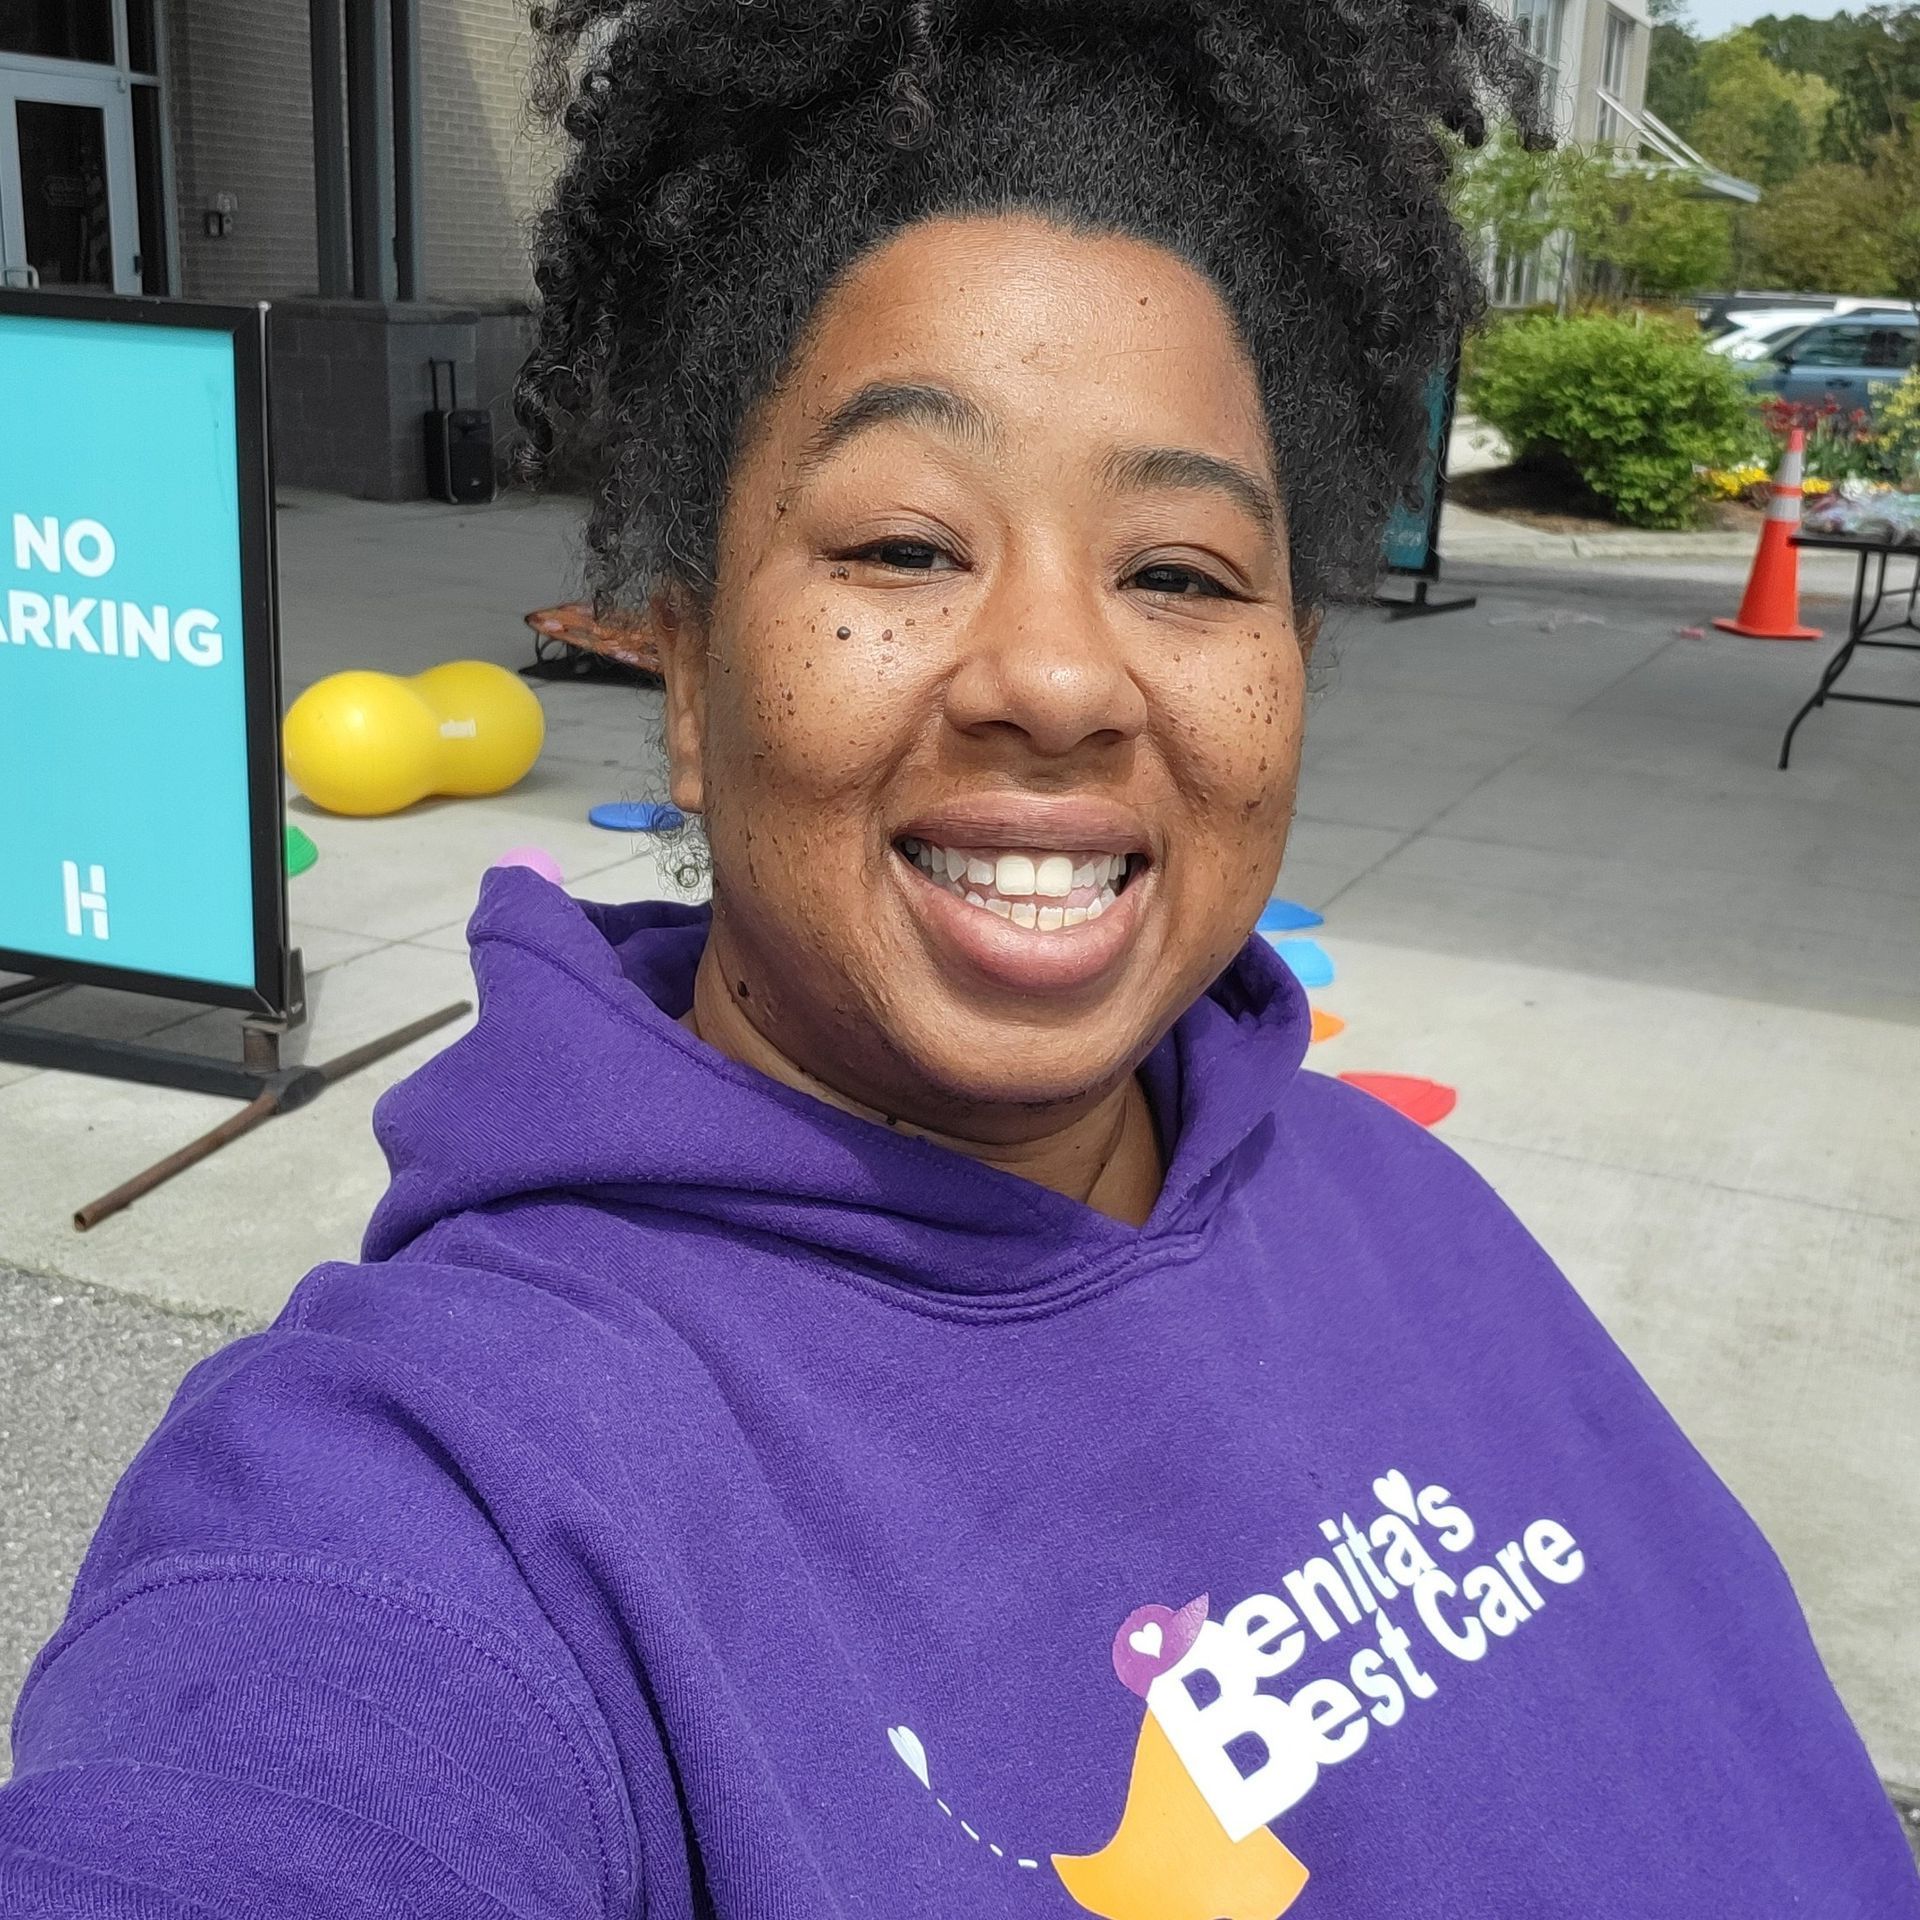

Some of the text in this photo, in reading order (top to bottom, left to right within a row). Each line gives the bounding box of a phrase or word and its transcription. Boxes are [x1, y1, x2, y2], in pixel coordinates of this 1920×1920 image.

[13, 513, 116, 578] NO
[0, 588, 224, 667] RKING
[62, 860, 110, 940] H
[1146, 1468, 1475, 1843] Benita's
[1146, 1518, 1585, 1843] Best Care
